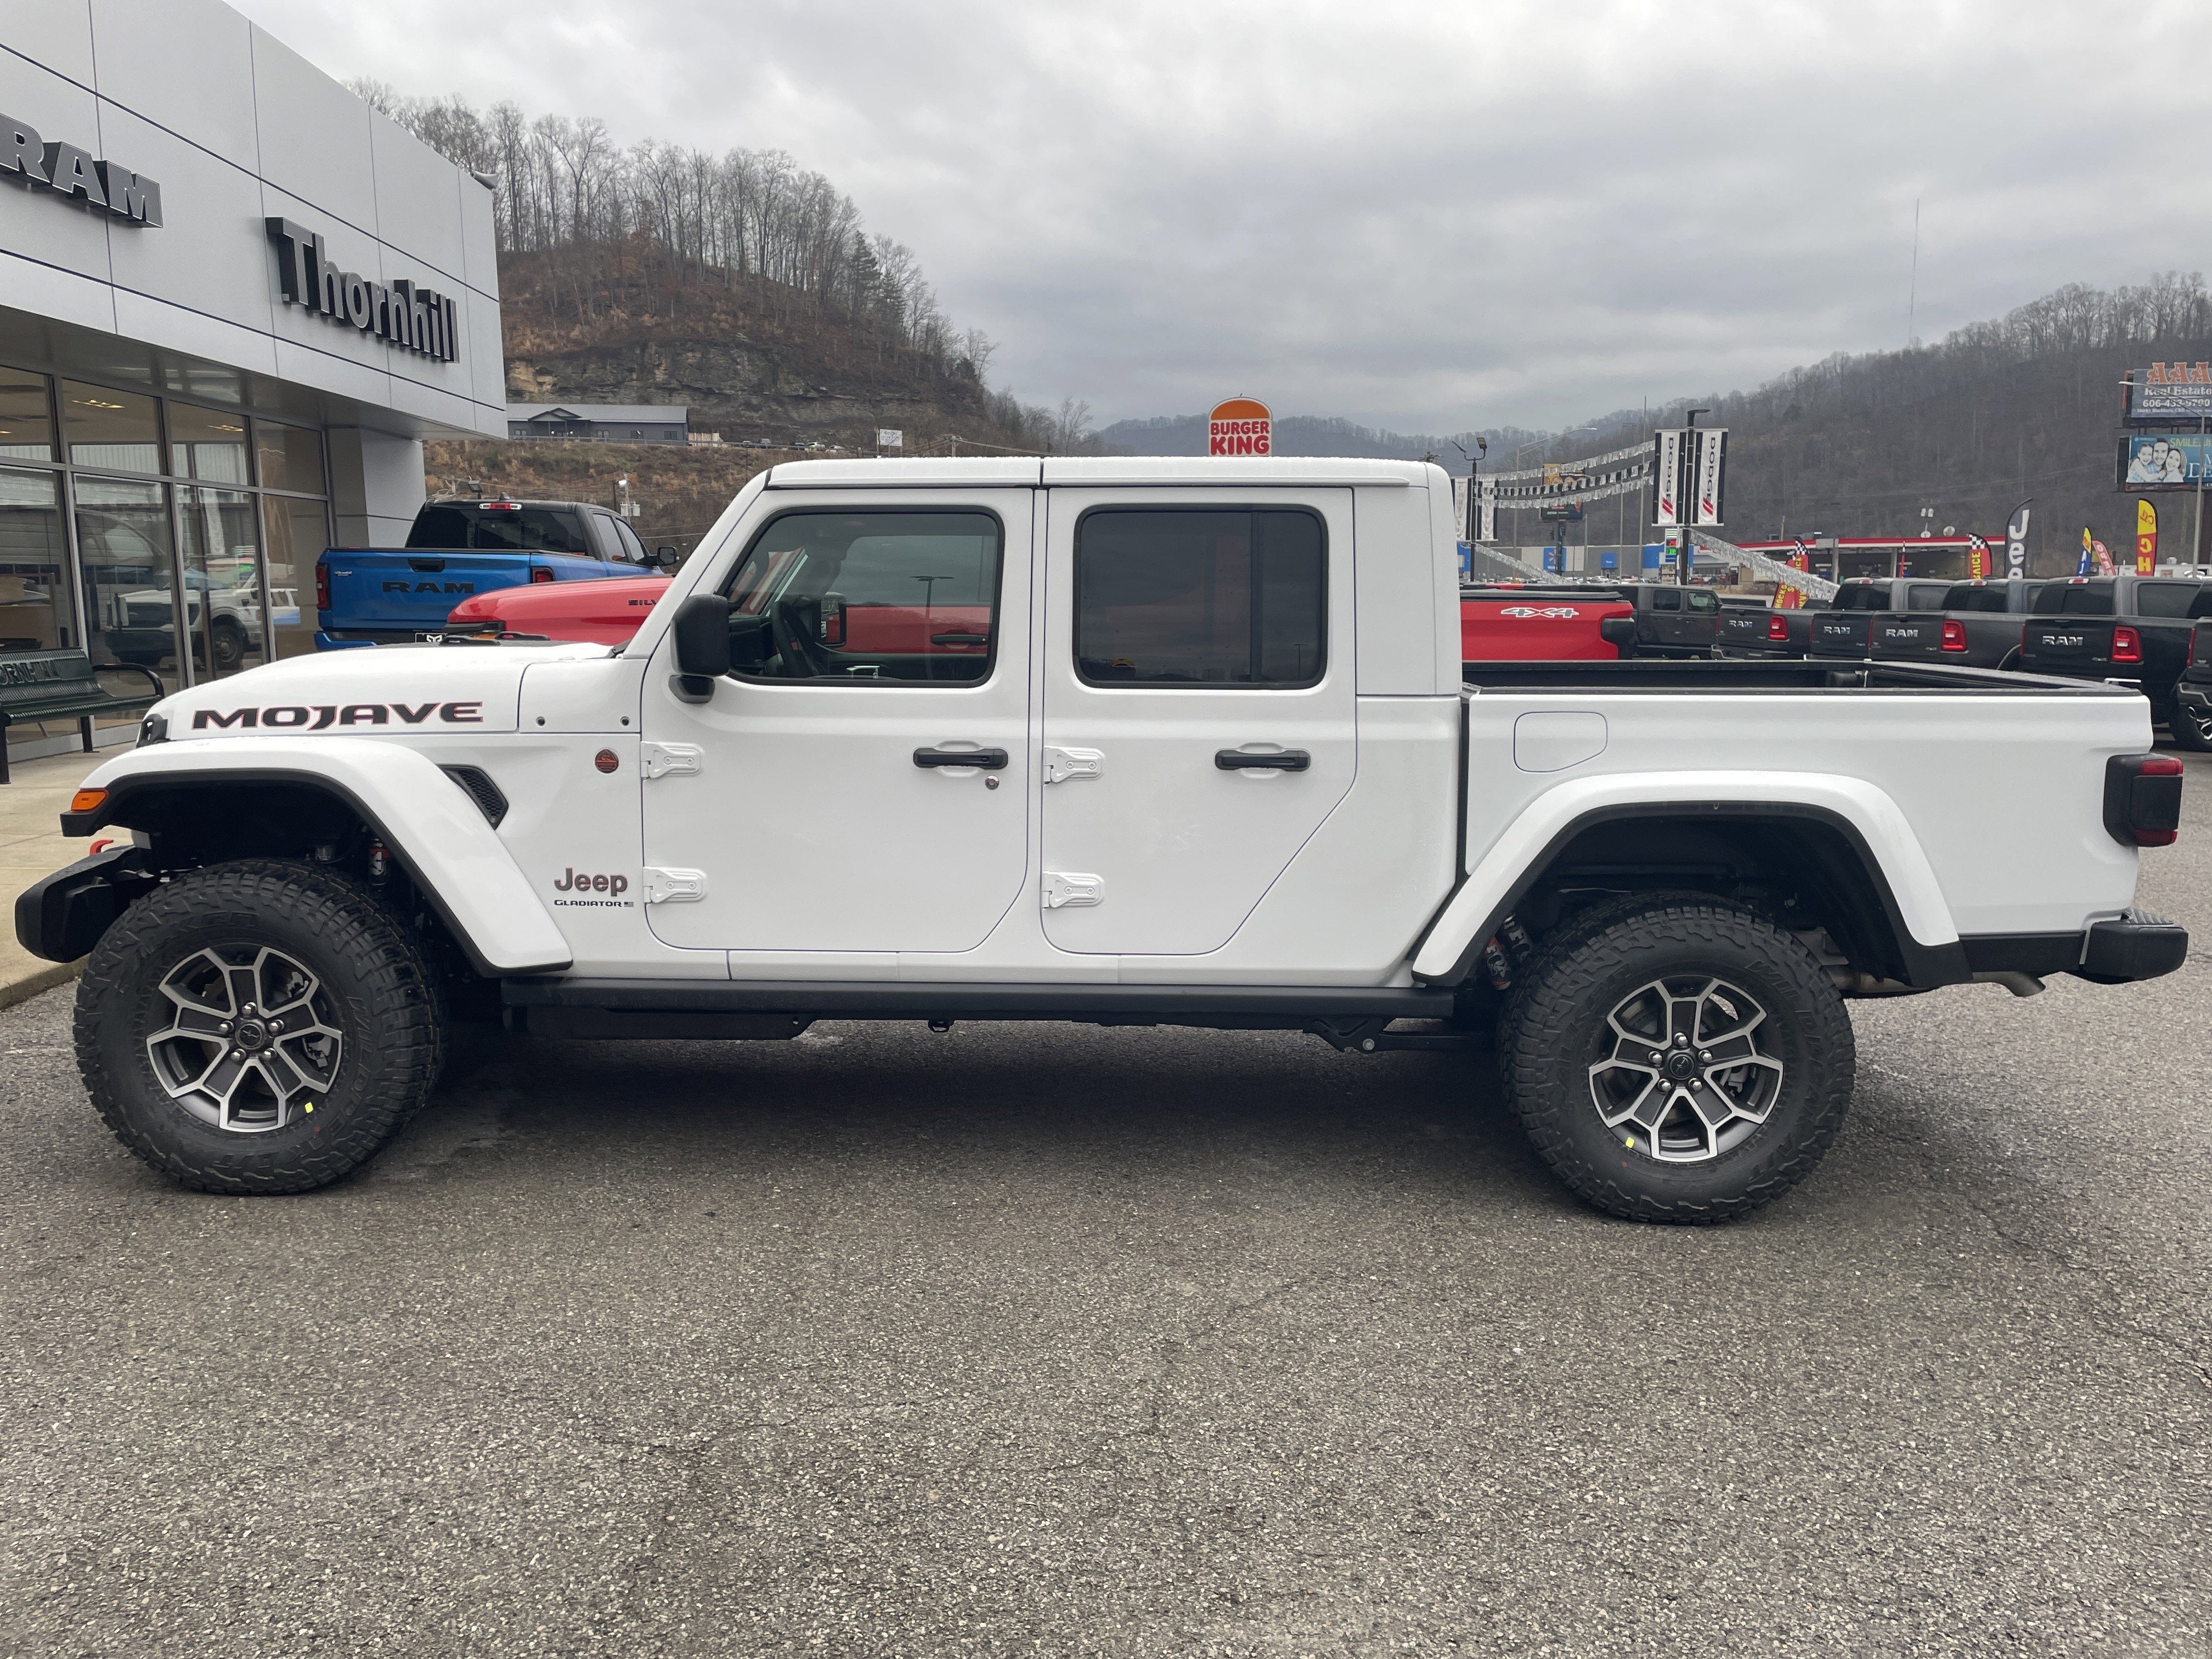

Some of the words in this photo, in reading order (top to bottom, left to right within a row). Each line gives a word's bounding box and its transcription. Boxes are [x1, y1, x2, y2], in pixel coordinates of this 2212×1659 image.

[0, 112, 163, 228] RAM
[265, 217, 460, 364] Thornhill
[2147, 362, 2212, 385] AAA
[1210, 421, 1269, 436] BURGER
[1210, 435, 1269, 455] KING
[1666, 438, 1674, 504] DODGE
[1706, 438, 1716, 503] DODGE
[382, 582, 474, 594] RAM
[1729, 620, 1753, 628] RAM
[1824, 626, 1850, 634] RAM
[1886, 629, 1918, 637] RAM
[2042, 635, 2084, 646] RAM
[191, 701, 484, 731] MOJAVE
[554, 867, 628, 896] Jeep
